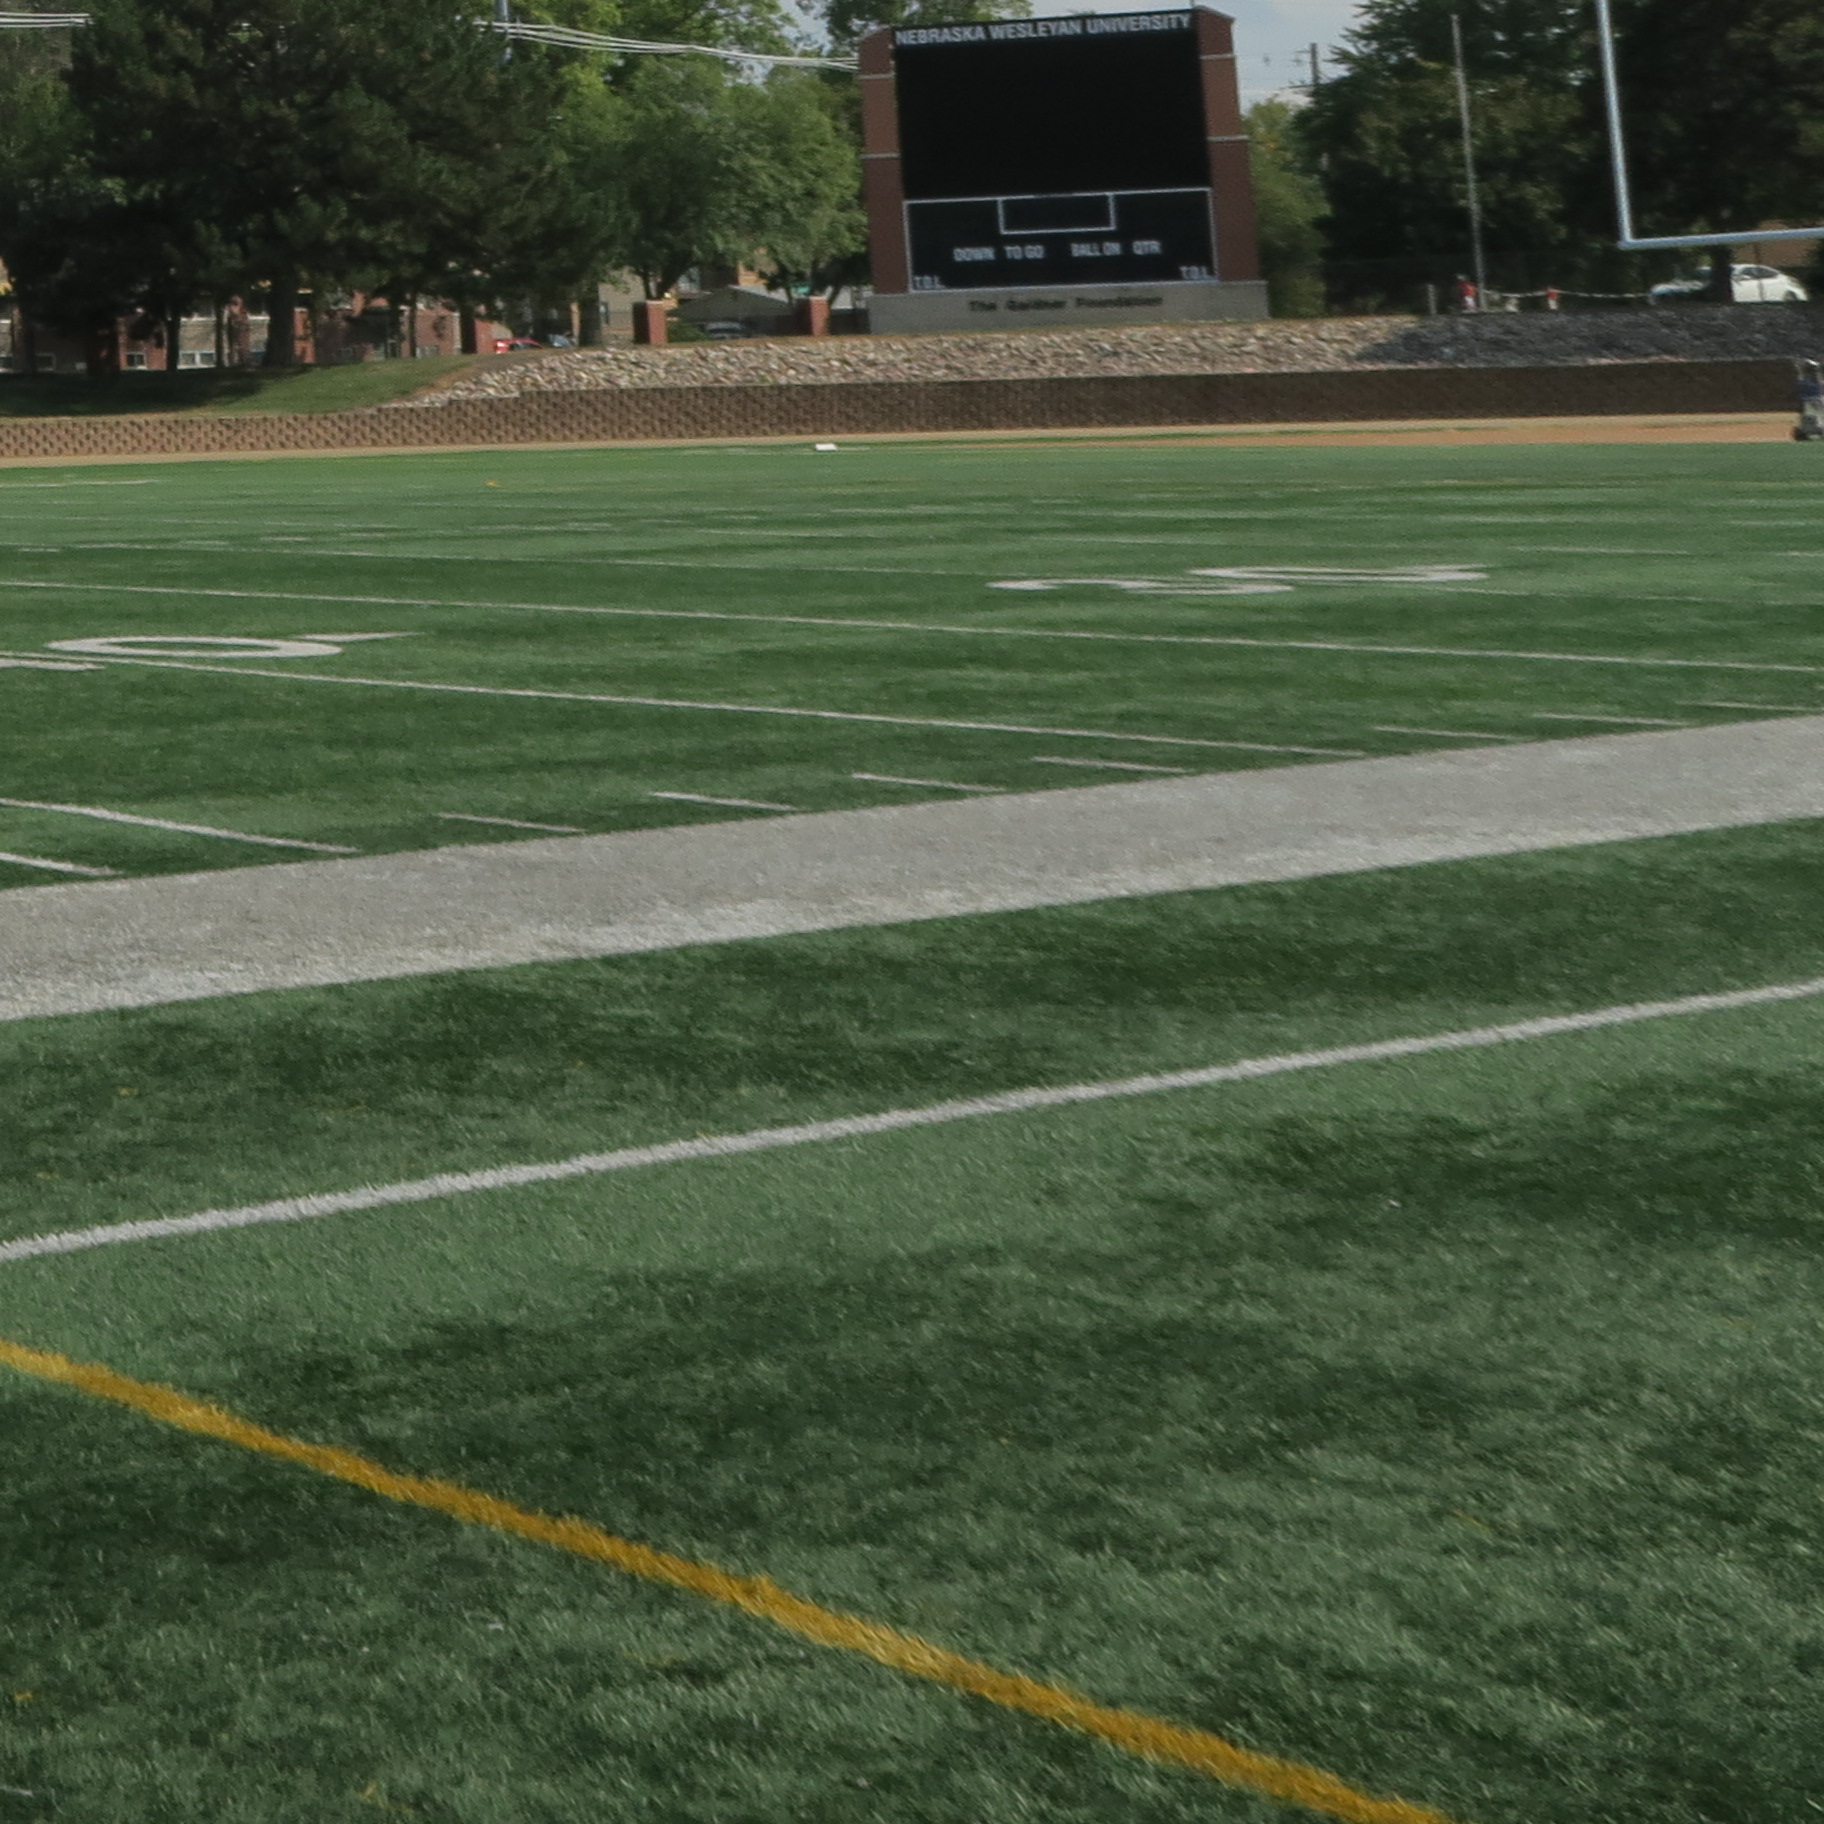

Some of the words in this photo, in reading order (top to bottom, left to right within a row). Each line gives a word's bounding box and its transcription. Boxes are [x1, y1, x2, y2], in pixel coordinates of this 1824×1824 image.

[895, 26, 986, 44] NEBRASKA
[989, 19, 1082, 40] WESLEYAN
[1086, 13, 1192, 34] UNIVERSITY
[953, 247, 995, 261] DOWN
[1004, 246, 1022, 259] TO
[1133, 241, 1162, 254] QTR
